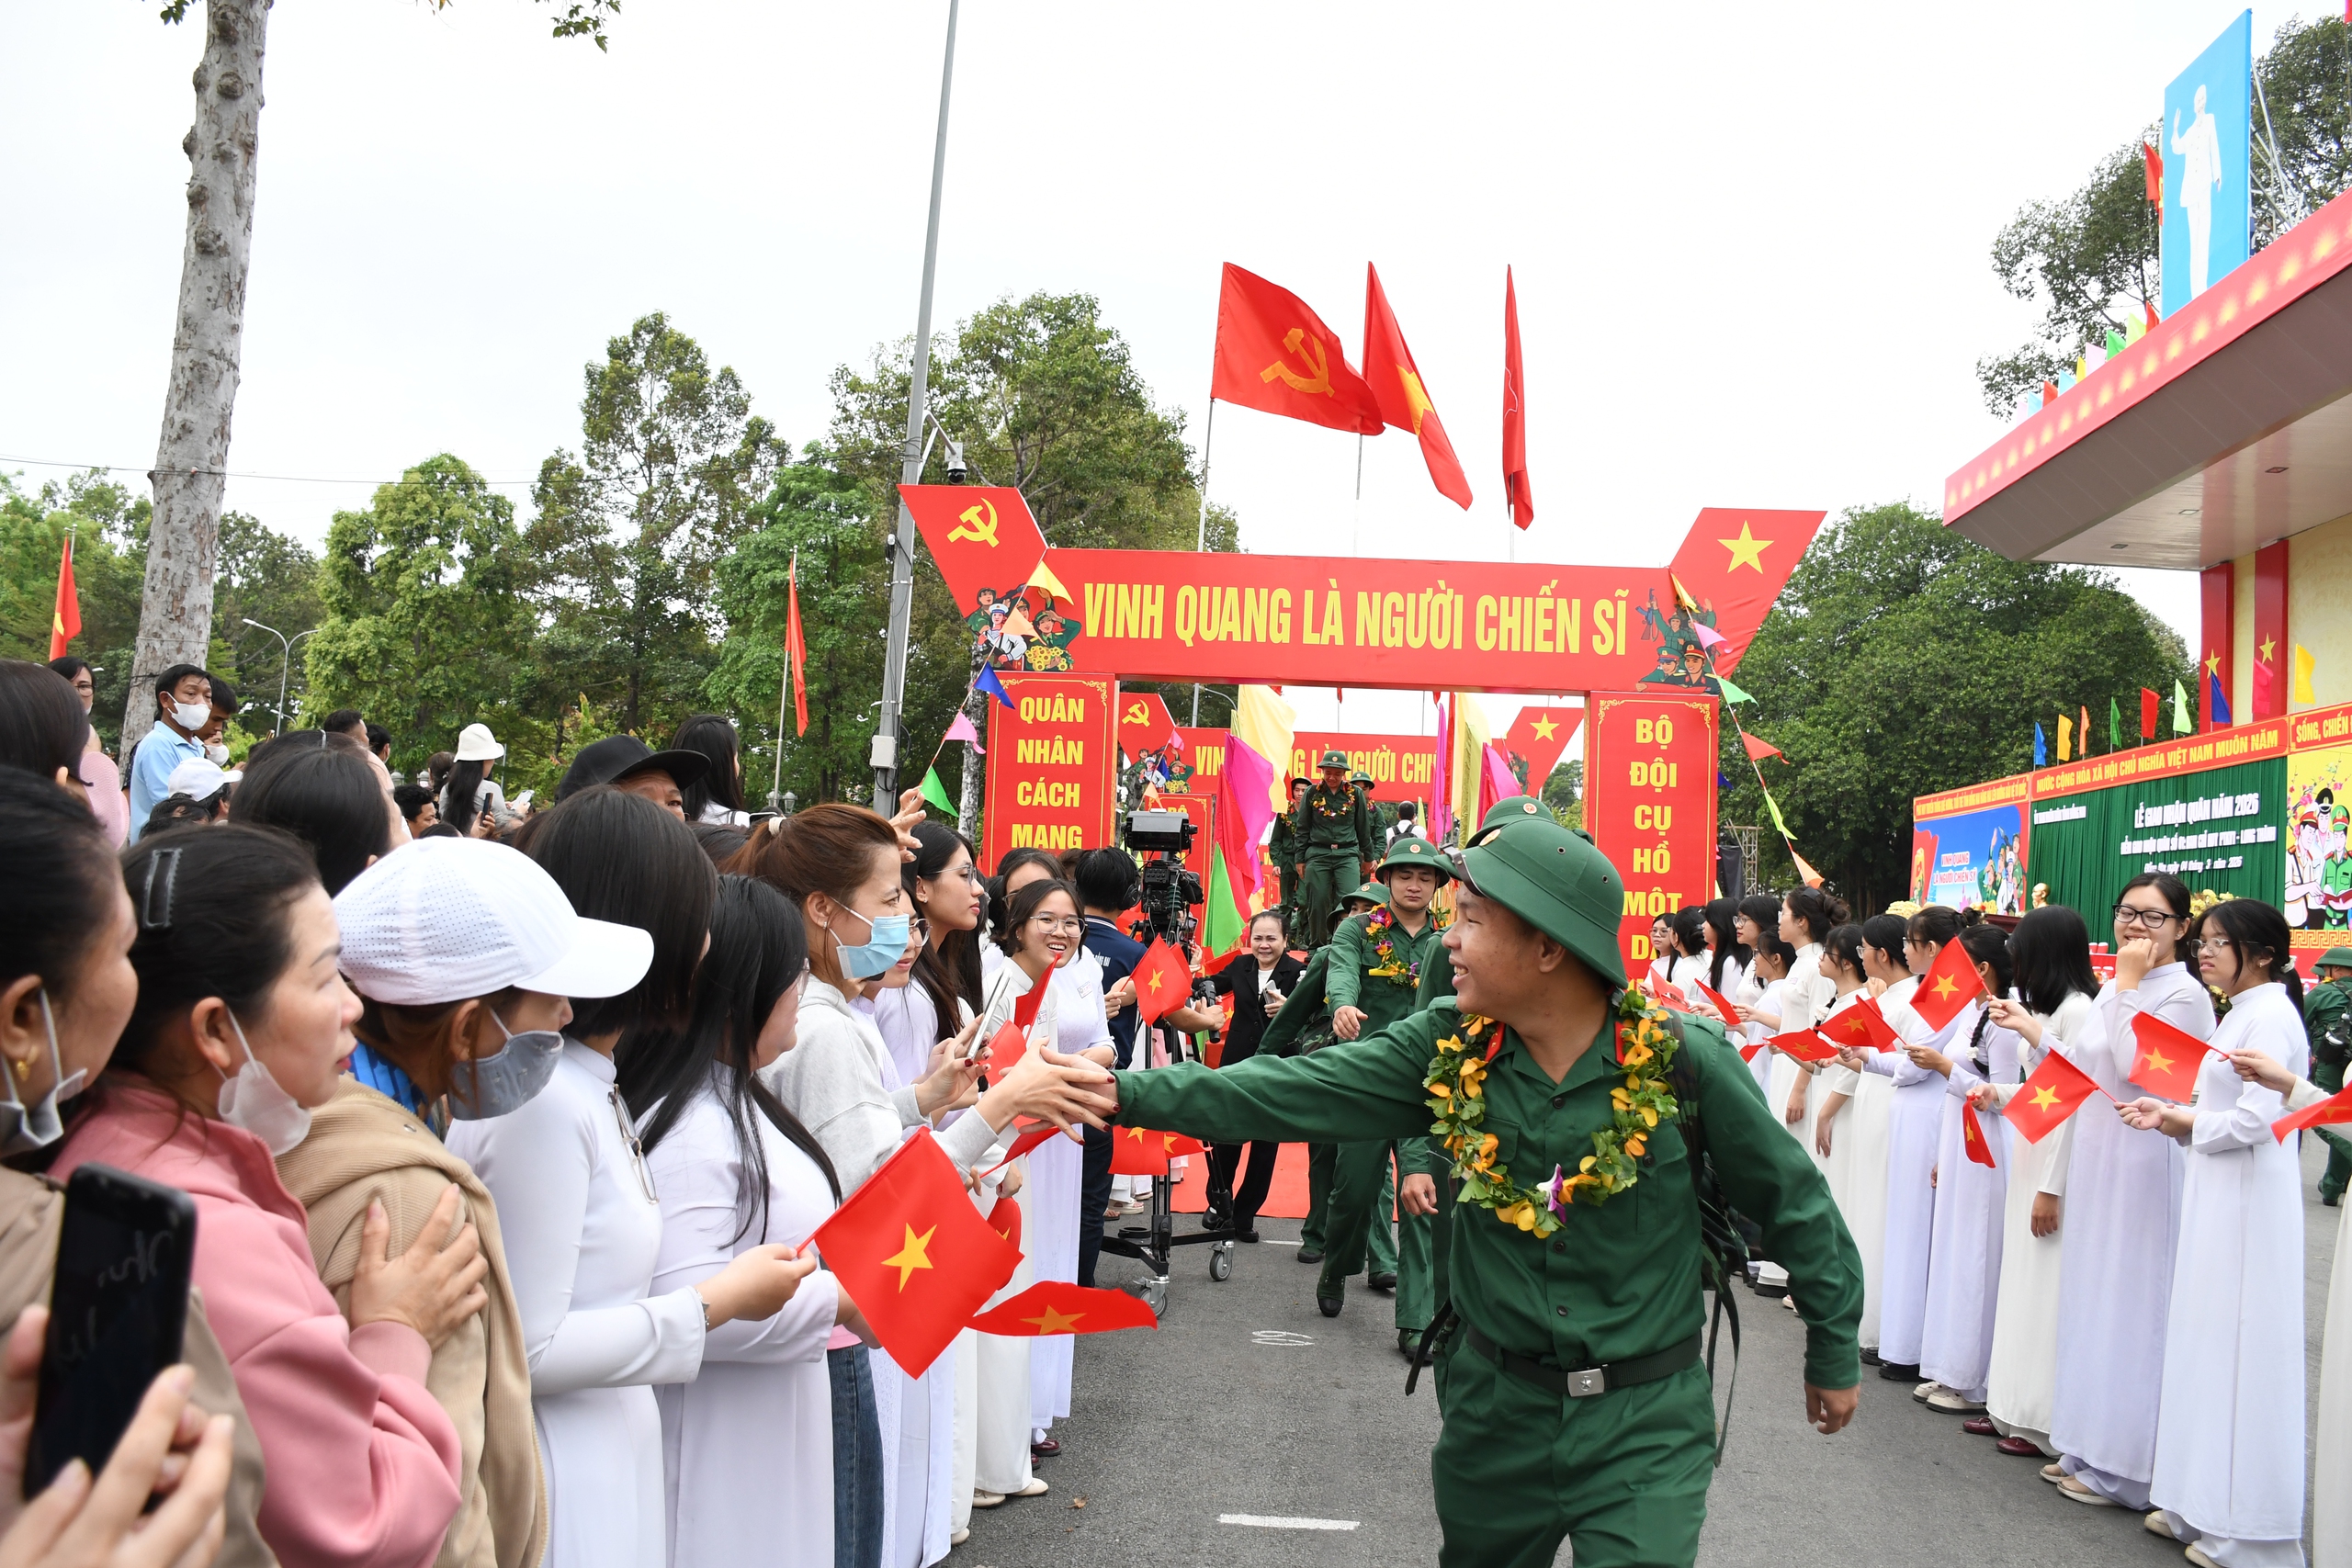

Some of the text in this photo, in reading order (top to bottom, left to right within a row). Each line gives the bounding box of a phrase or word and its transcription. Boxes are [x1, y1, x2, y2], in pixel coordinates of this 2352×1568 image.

[1084, 579, 1629, 655] VINH QUANG LÀ NGƯỜI CHIẾN SĨ
[1020, 693, 1084, 724] QUÂN
[1635, 715, 1673, 750] BỘ
[2296, 711, 2348, 742] SỐNG, CHIẾN
[1017, 735, 1083, 765] NHÂN
[1195, 745, 1226, 776] VIN
[2037, 728, 2278, 793] NƯỚC CỘNG HÒA XÃ HỘI CHỦ NGHĨA VIỆT NAM MUÔN NĂM
[1629, 757, 1678, 793] ĐỘI
[1017, 777, 1080, 807] CÁCH
[1634, 805, 1672, 836] CỤ
[2134, 793, 2259, 829] LỄ GIAO NHẬN QUÂN NĂM 2026
[1633, 840, 1671, 874] HỒ
[2205, 858, 2211, 870] 3
[1623, 886, 1682, 920] MỘT
